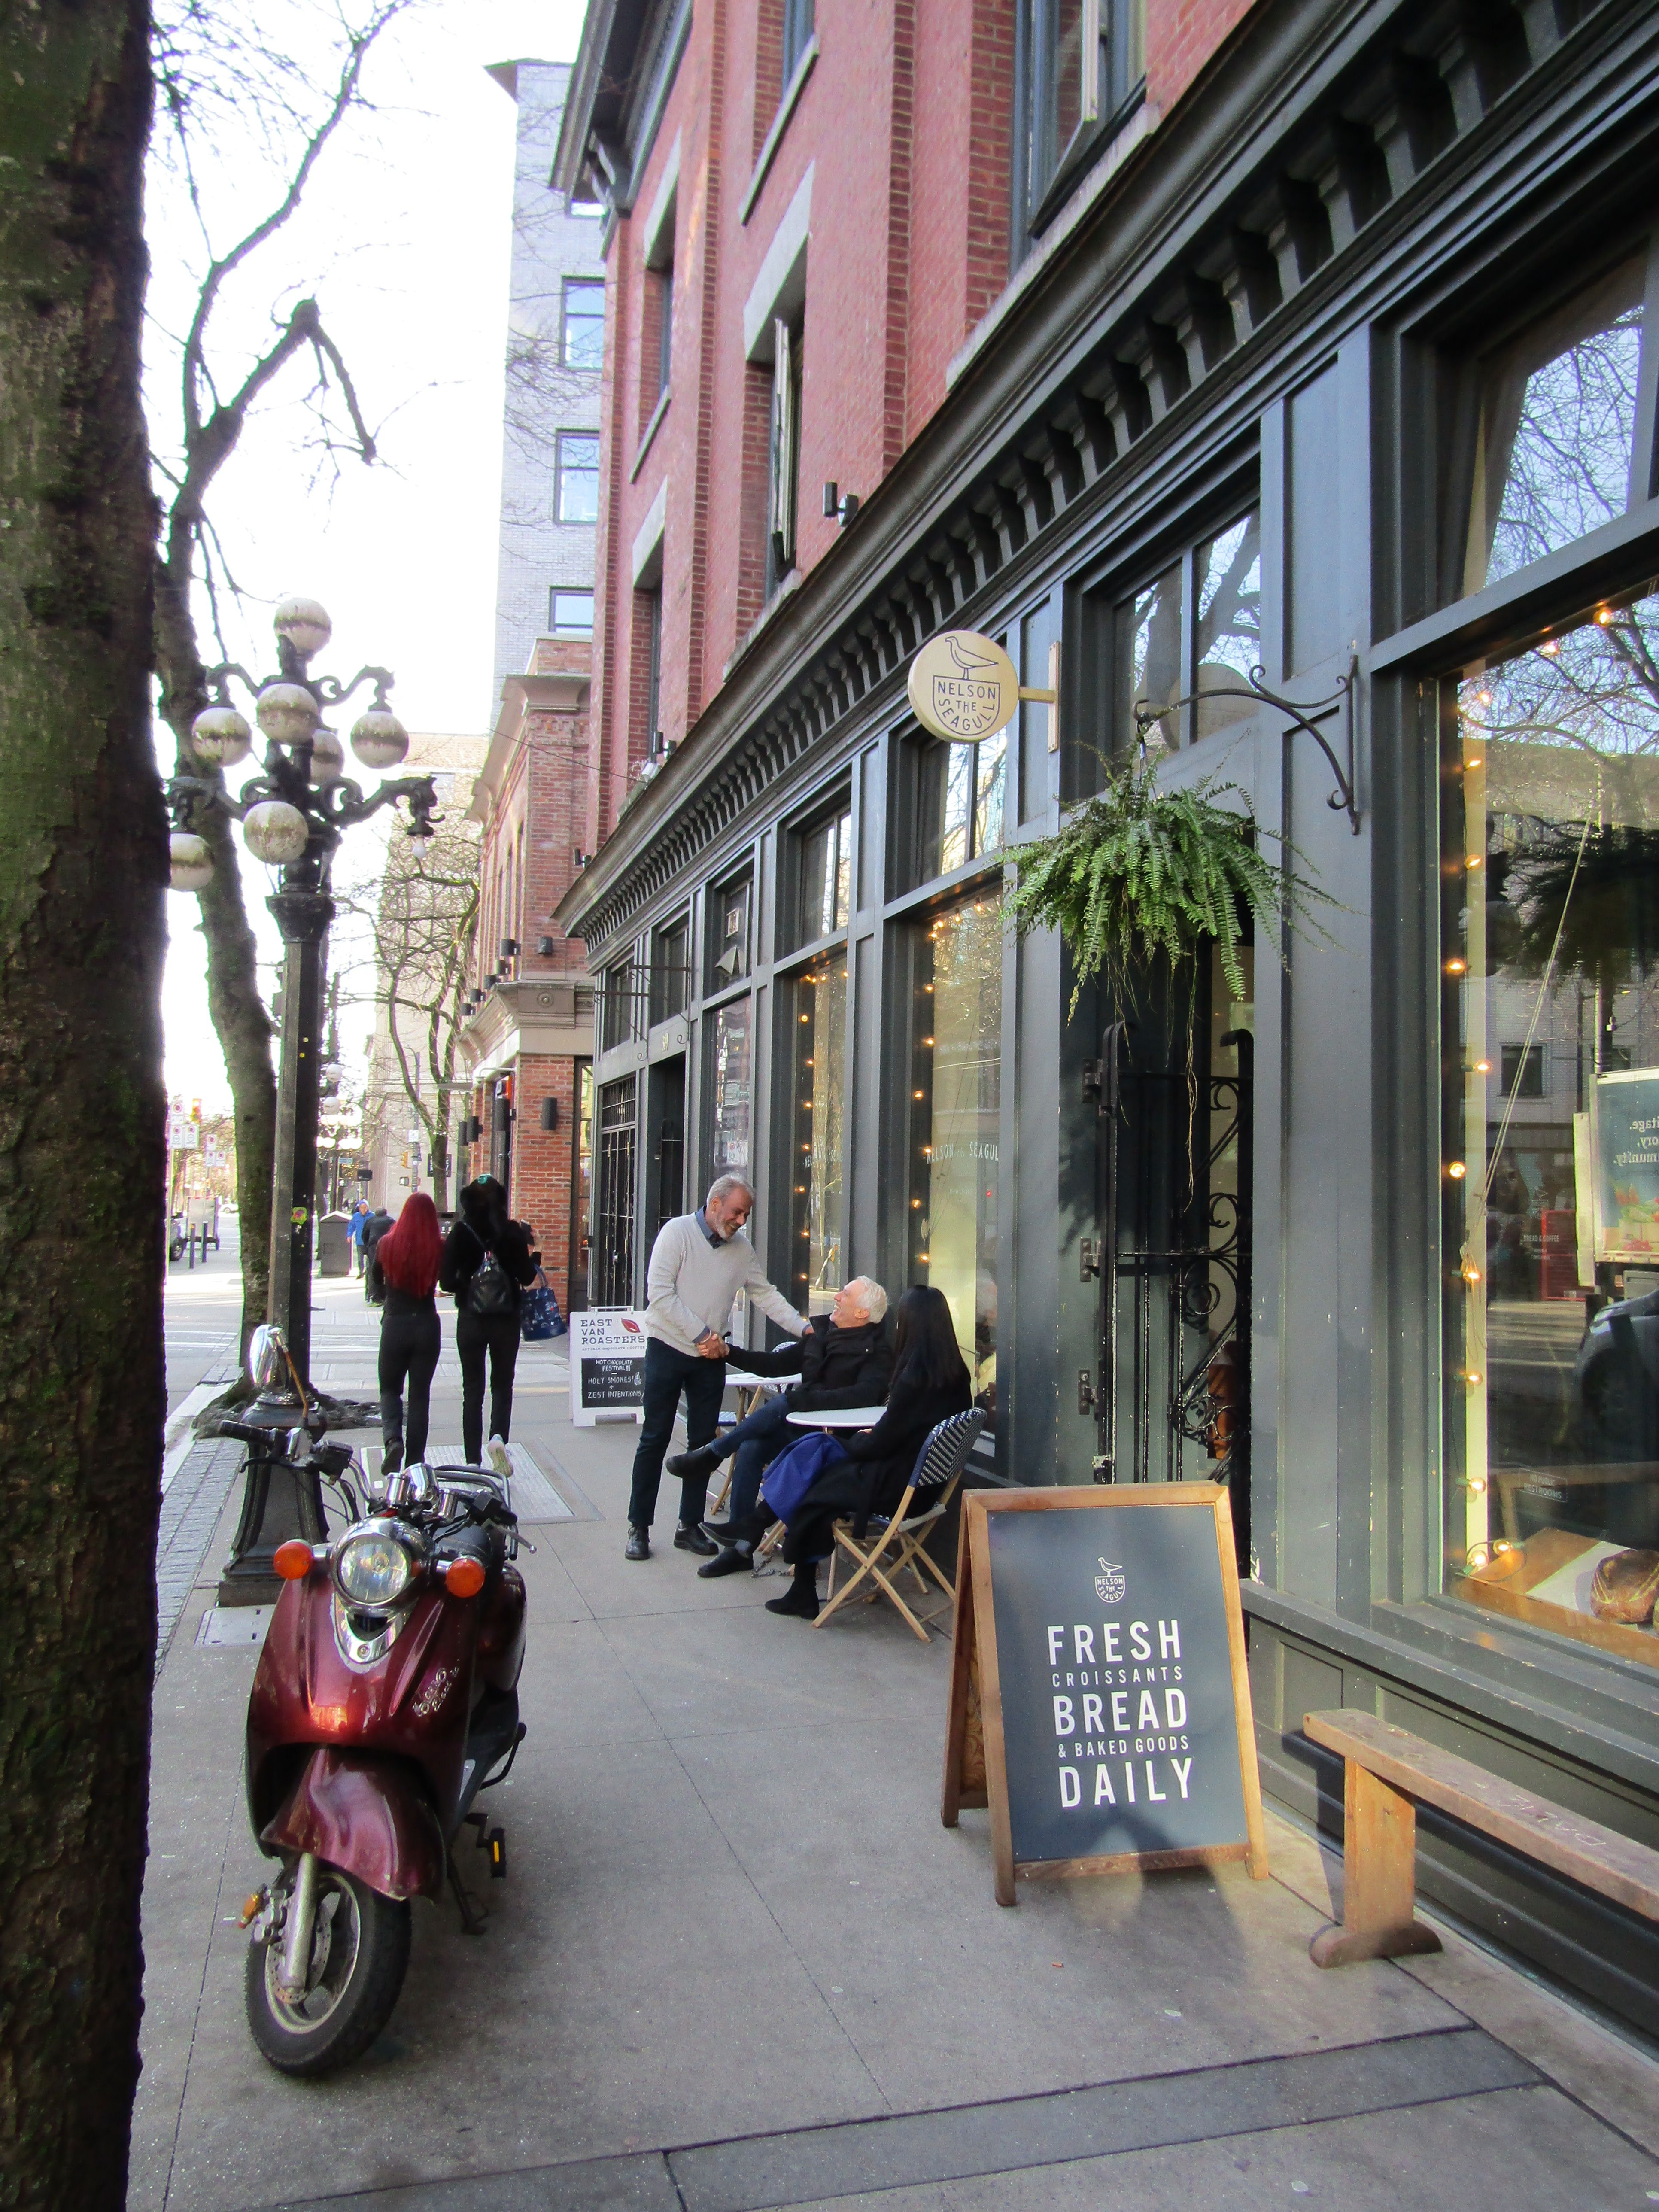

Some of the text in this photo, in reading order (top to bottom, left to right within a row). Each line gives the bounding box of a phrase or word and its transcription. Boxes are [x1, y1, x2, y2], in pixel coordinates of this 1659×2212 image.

[938, 681, 995, 700] NELSON
[938, 698, 995, 731] SEAGULL
[956, 700, 977, 713] THE
[927, 1143, 954, 1164] NELSON
[969, 1141, 999, 1162] SEAGUL
[581, 1336, 645, 1345] ROASTERS
[608, 1375, 634, 1384] SMOKES!
[1523, 1482, 1562, 1499] RESTROOMS
[1098, 1586, 1123, 1601] SEAGULL
[1047, 1620, 1181, 1666] FRESH
[1052, 1665, 1183, 1688] CROISSANTS
[1053, 1688, 1188, 1735] BREAD
[1058, 1735, 1189, 1758] & BAKED GOODS
[1058, 1757, 1193, 1808] DAILY
